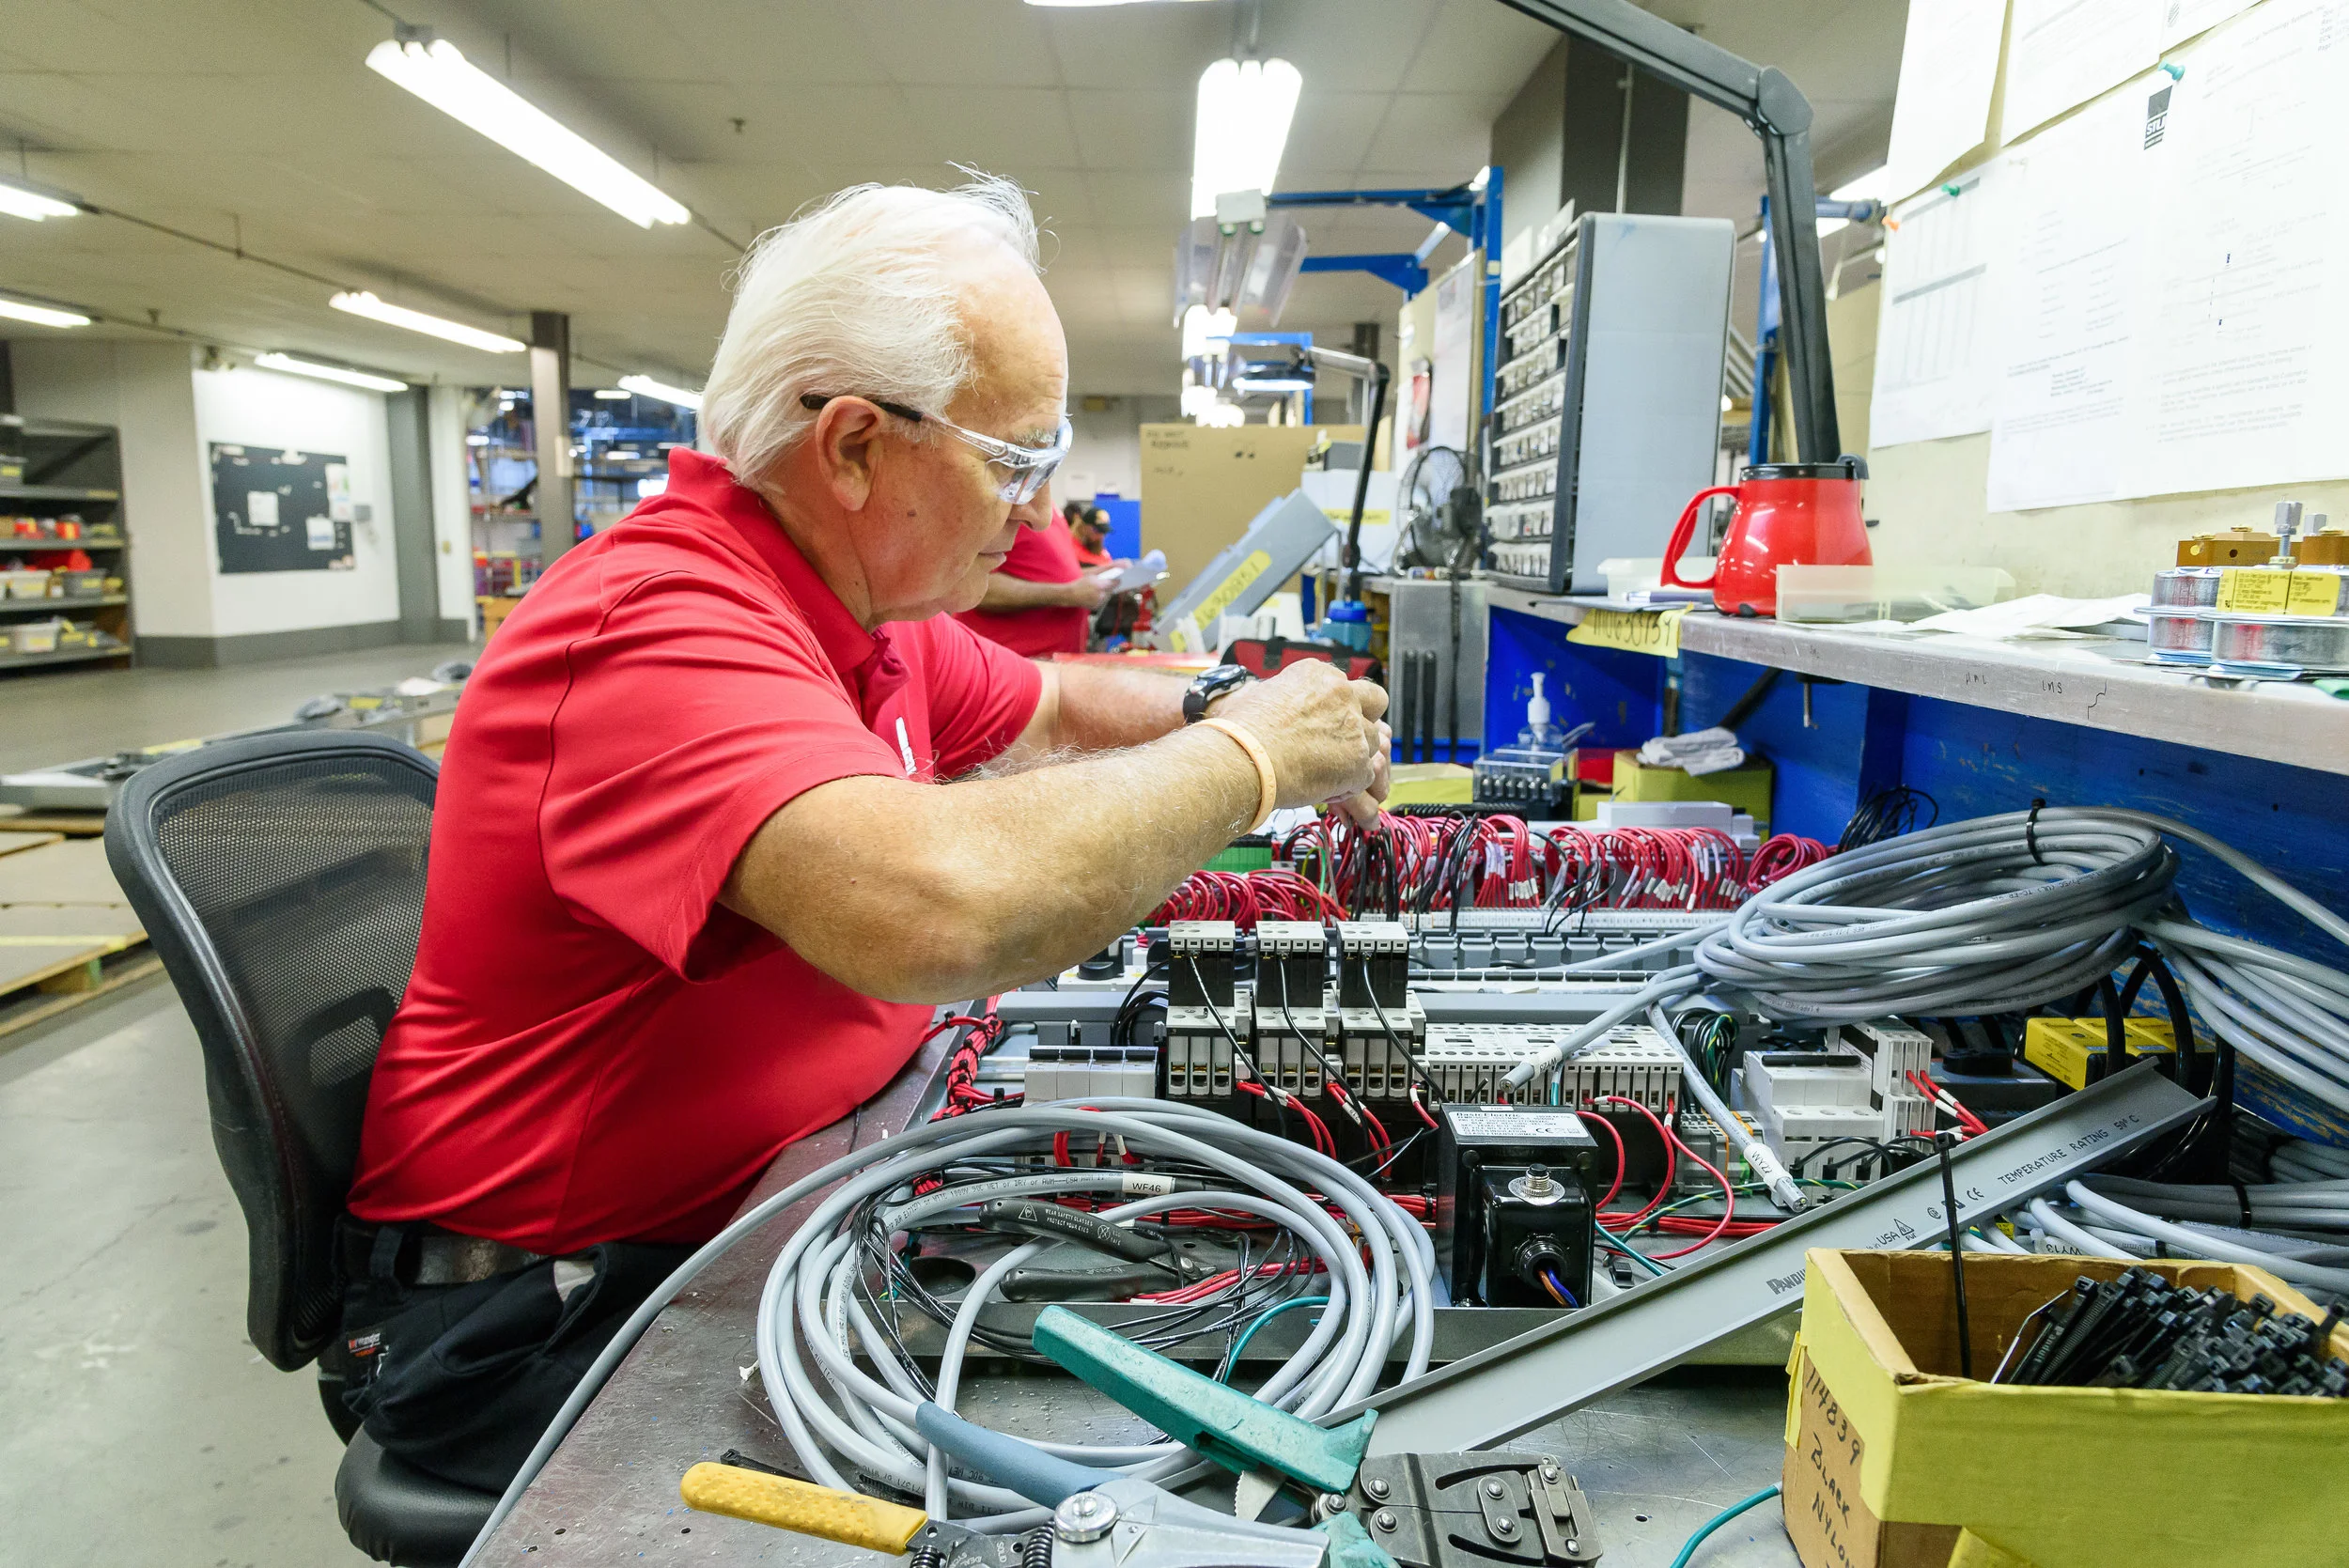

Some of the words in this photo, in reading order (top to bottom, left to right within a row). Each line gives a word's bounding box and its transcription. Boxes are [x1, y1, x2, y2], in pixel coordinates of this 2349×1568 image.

[1998, 1149, 2068, 1186] TEMPERATURE
[2069, 1127, 2109, 1152] RATING
[1132, 1181, 1162, 1194] WF46
[1046, 1217, 1066, 1227] PROTECT
[1058, 1210, 1074, 1221] SAFETY
[1876, 1231, 1900, 1248] USA
[1805, 1366, 1860, 1467] 114839
